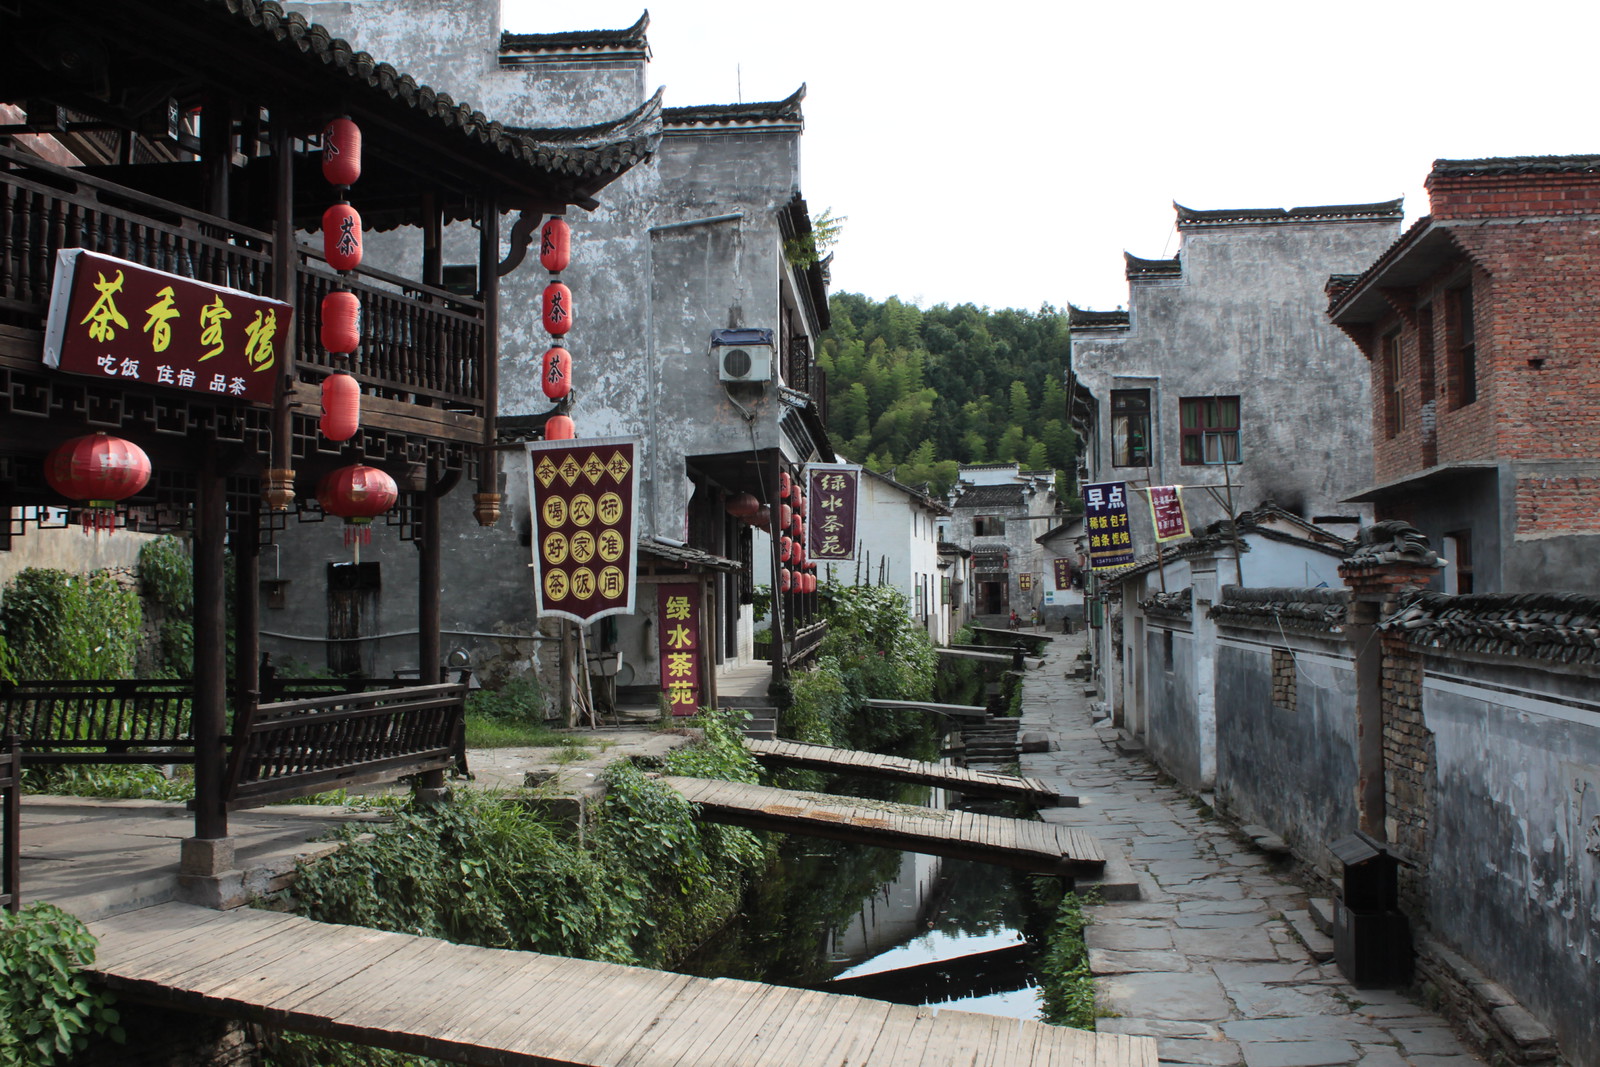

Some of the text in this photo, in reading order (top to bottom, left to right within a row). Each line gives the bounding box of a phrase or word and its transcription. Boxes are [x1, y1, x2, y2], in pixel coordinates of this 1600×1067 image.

[336, 216, 359, 256] 茶
[540, 226, 556, 256] 茶
[80, 269, 277, 373] 茶香客楼
[547, 291, 567, 323] 茶
[97, 353, 247, 395] 吃饭 住宿 品茶
[546, 354, 564, 383] 茶
[538, 459, 628, 480] 茶香客楼
[820, 474, 847, 554] 绿水茶苑
[1087, 486, 1125, 511] 早点
[1091, 533, 1110, 547] 油条
[1110, 513, 1127, 527] 包子
[547, 501, 564, 595] 喝好茶
[573, 500, 591, 595] 农家饭
[601, 498, 620, 592] 标准间
[666, 596, 694, 705] 绿水茶苑
